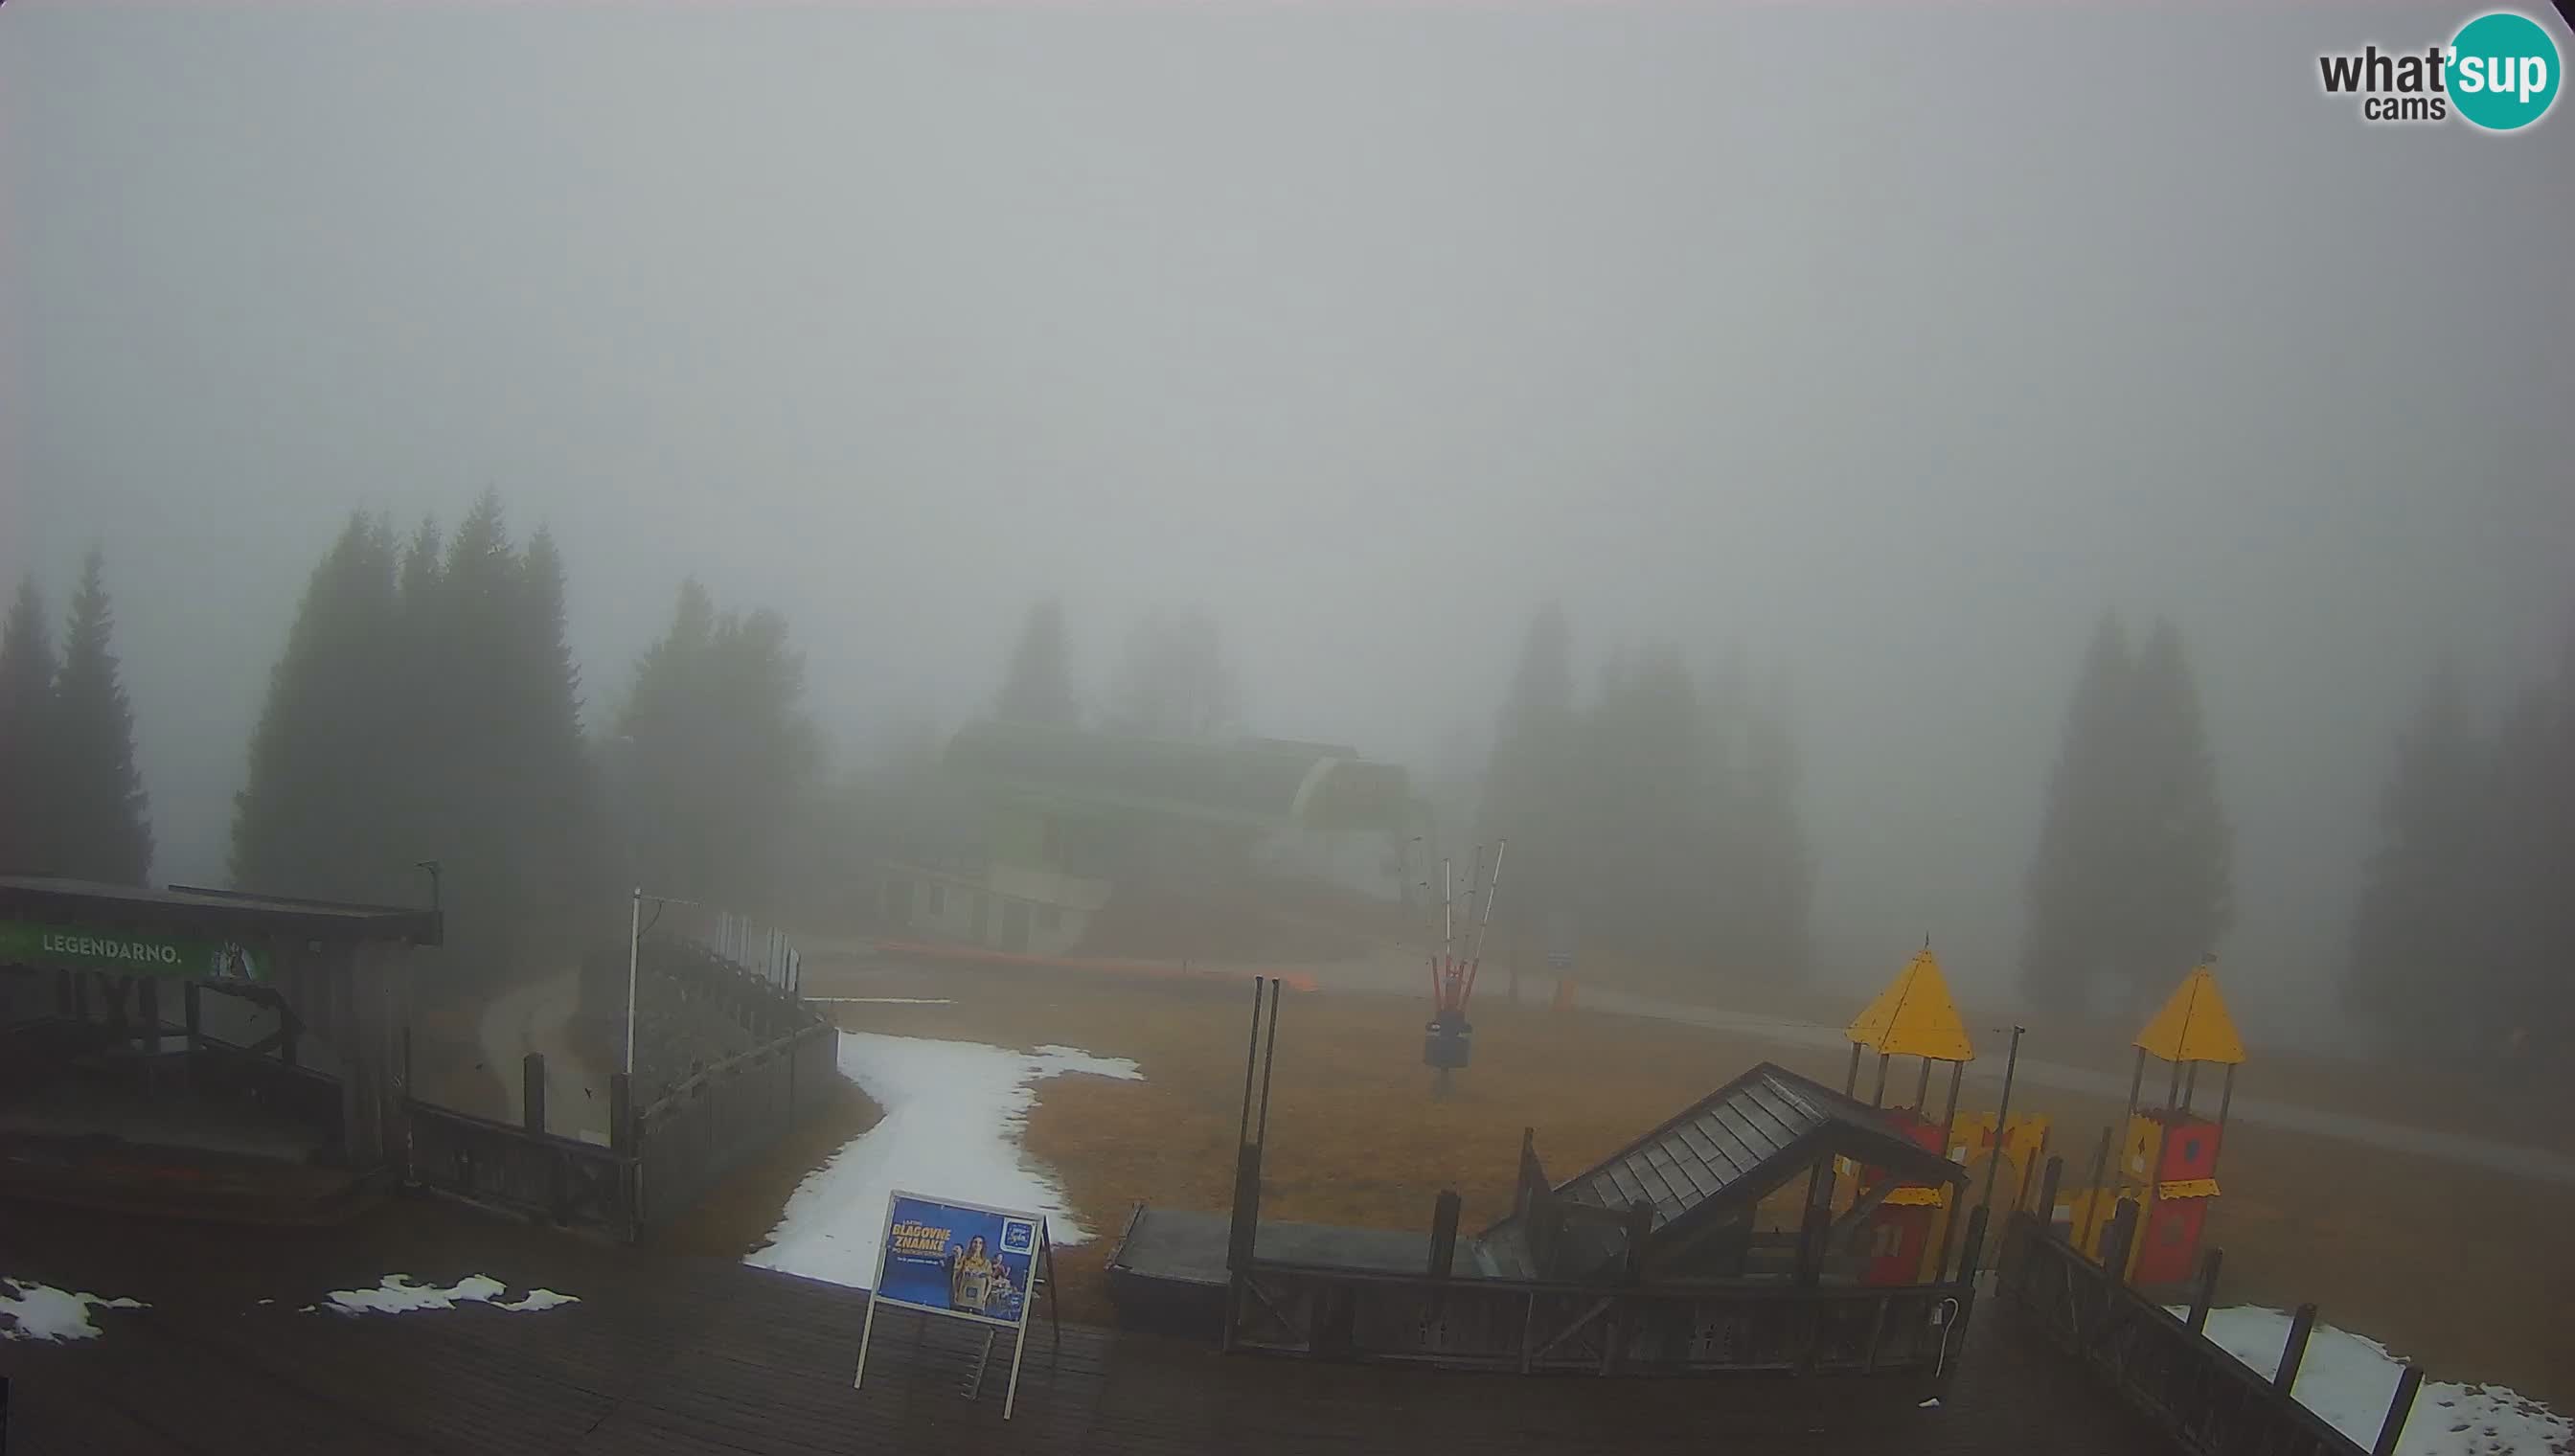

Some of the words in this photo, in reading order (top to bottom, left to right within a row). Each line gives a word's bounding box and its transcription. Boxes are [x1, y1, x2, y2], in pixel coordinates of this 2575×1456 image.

[43, 934, 182, 964] LEGENDARNO.
[892, 1223, 951, 1240] BLAGOVNE
[895, 1236, 946, 1252] ZNAMKE
